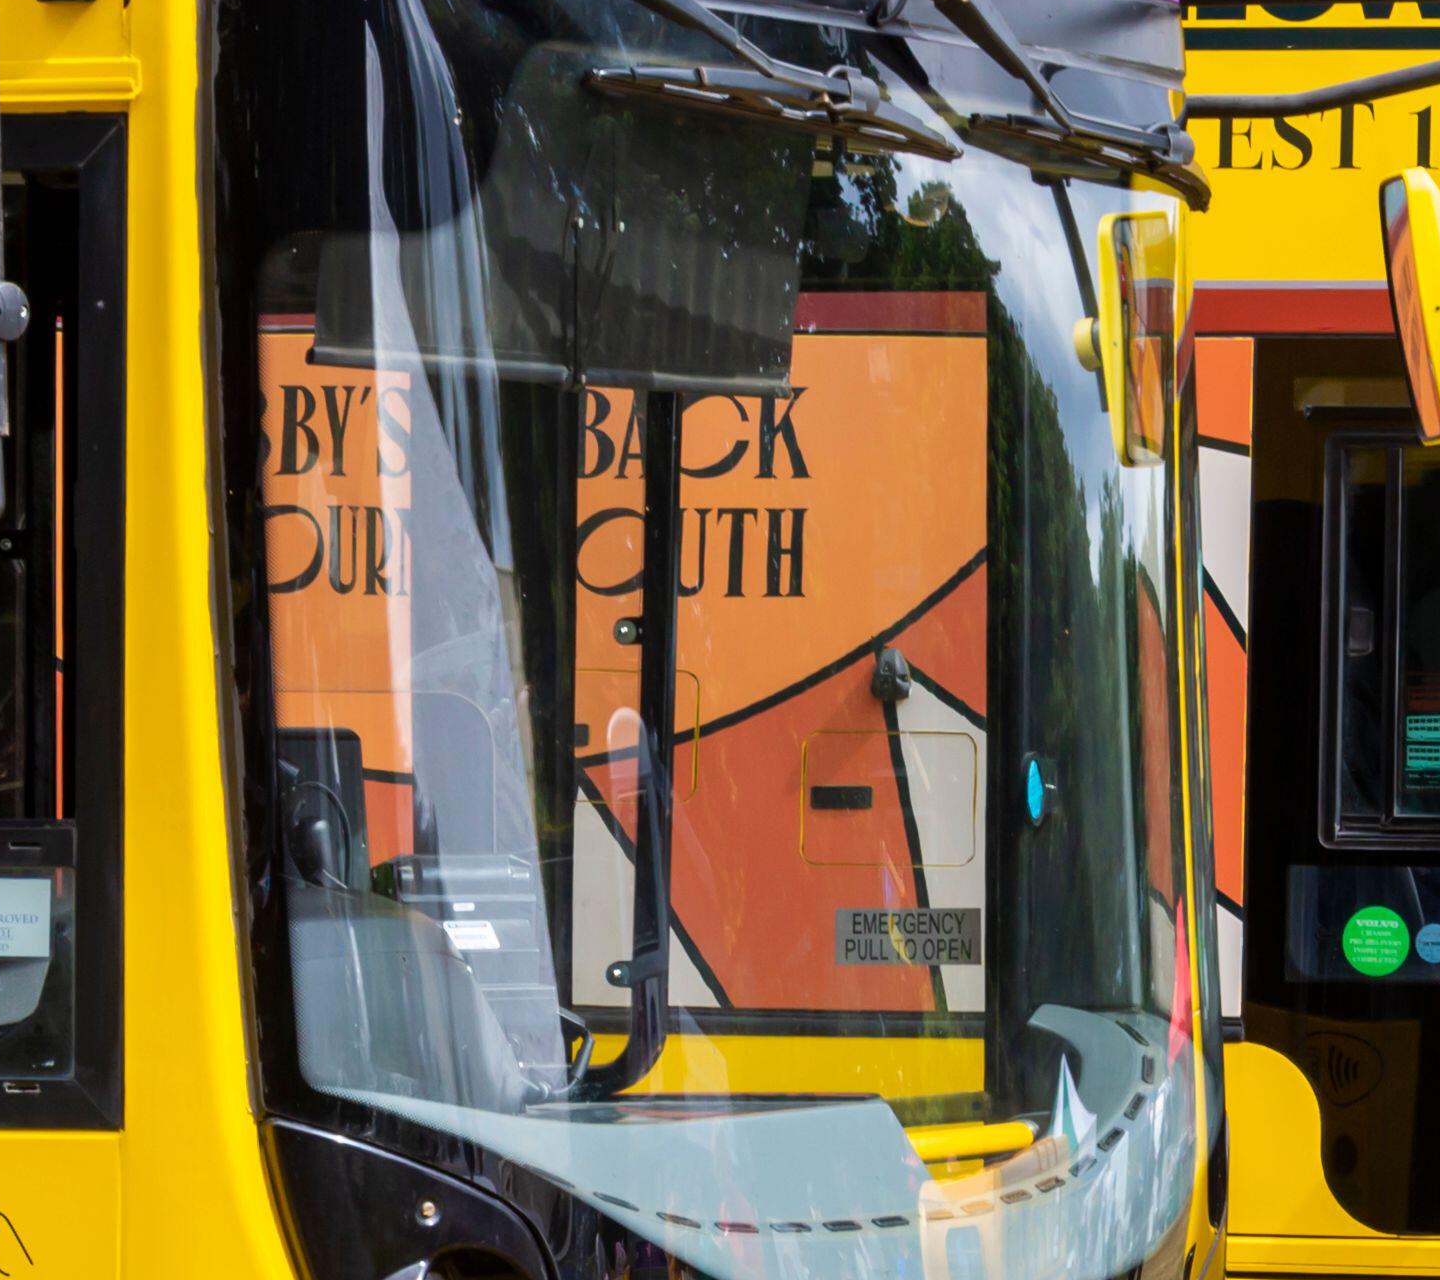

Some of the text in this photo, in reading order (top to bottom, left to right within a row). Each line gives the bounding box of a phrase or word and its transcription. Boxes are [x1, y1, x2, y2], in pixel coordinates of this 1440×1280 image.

[1211, 102, 1376, 171] EST
[260, 384, 411, 478] BY'S
[852, 912, 966, 935] EMERGENCY
[845, 938, 973, 961] PULL TO OPEN
